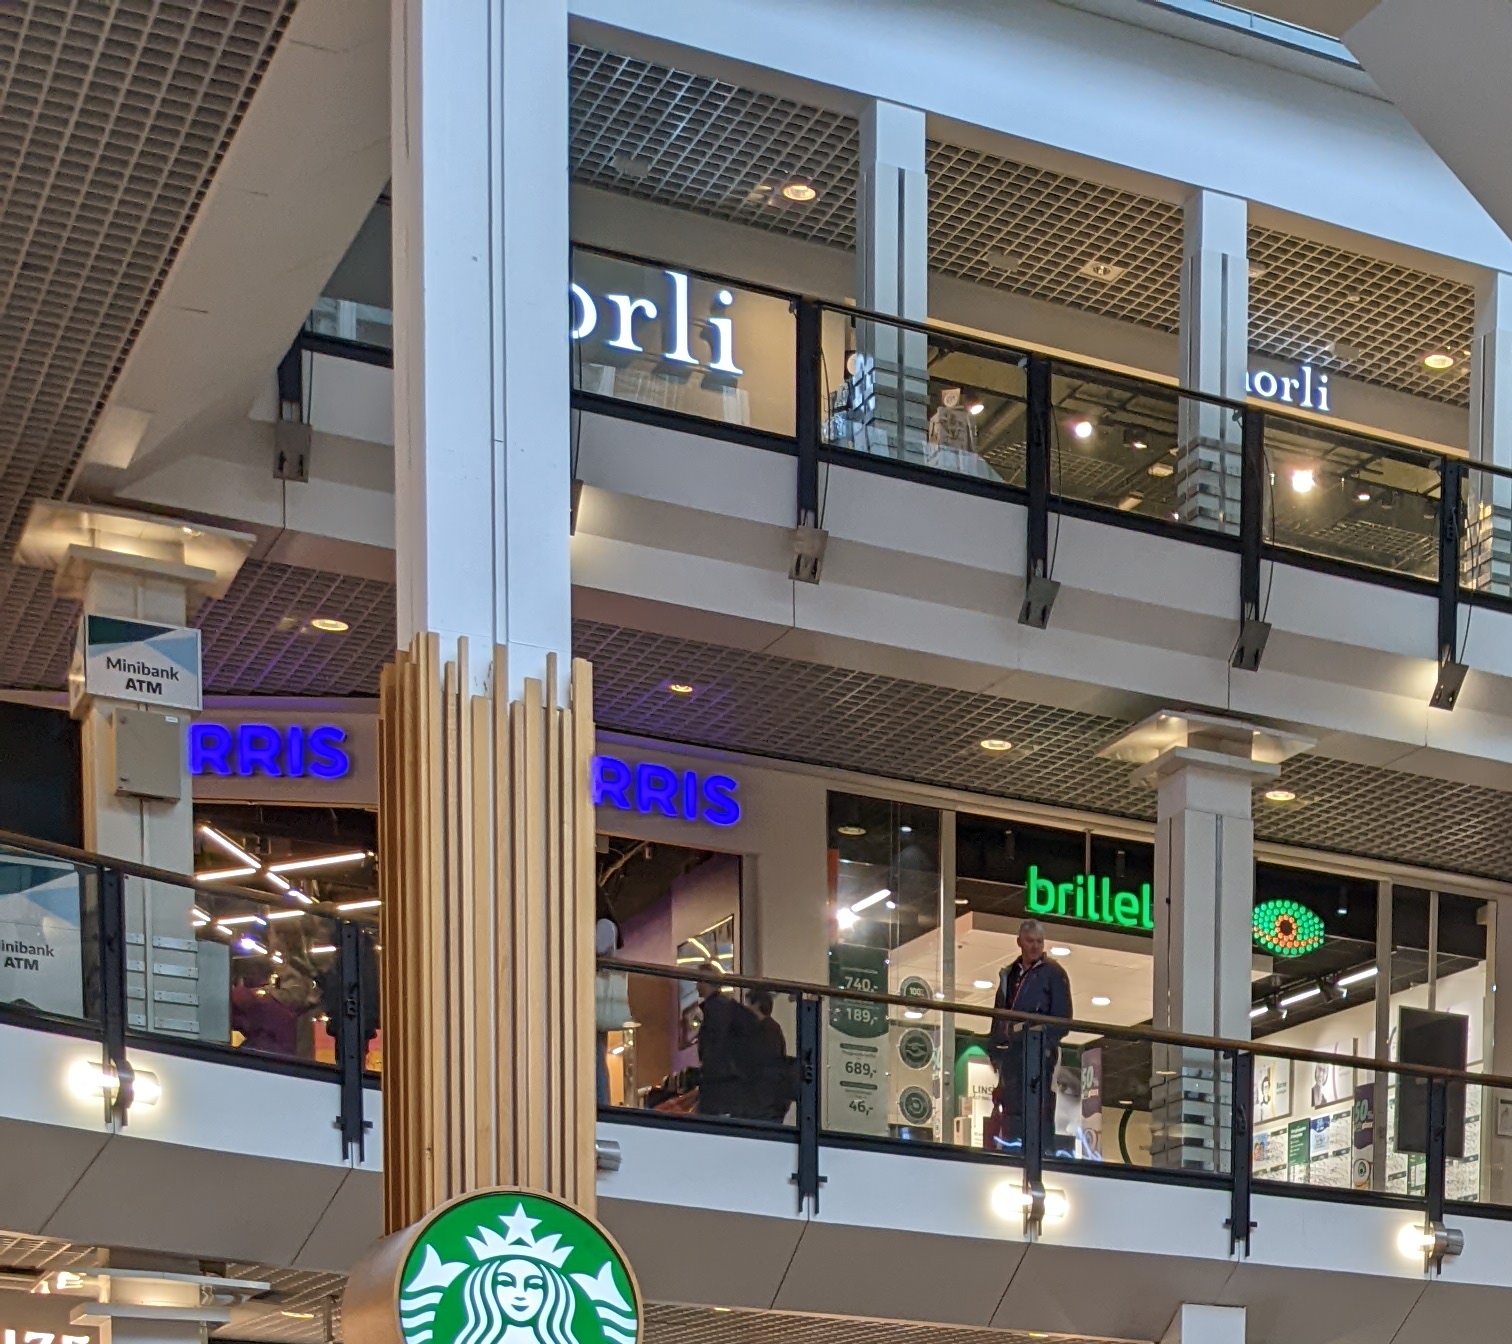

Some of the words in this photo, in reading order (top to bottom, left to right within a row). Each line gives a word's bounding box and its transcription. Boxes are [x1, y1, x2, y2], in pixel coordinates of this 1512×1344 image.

[106, 656, 180, 682] Minibank
[125, 677, 163, 695] ATM
[1, 940, 55, 957] inibank
[4, 956, 39, 971] ATM
[844, 1061, 877, 1079] 689,-
[848, 1100, 874, 1116] 46,-
